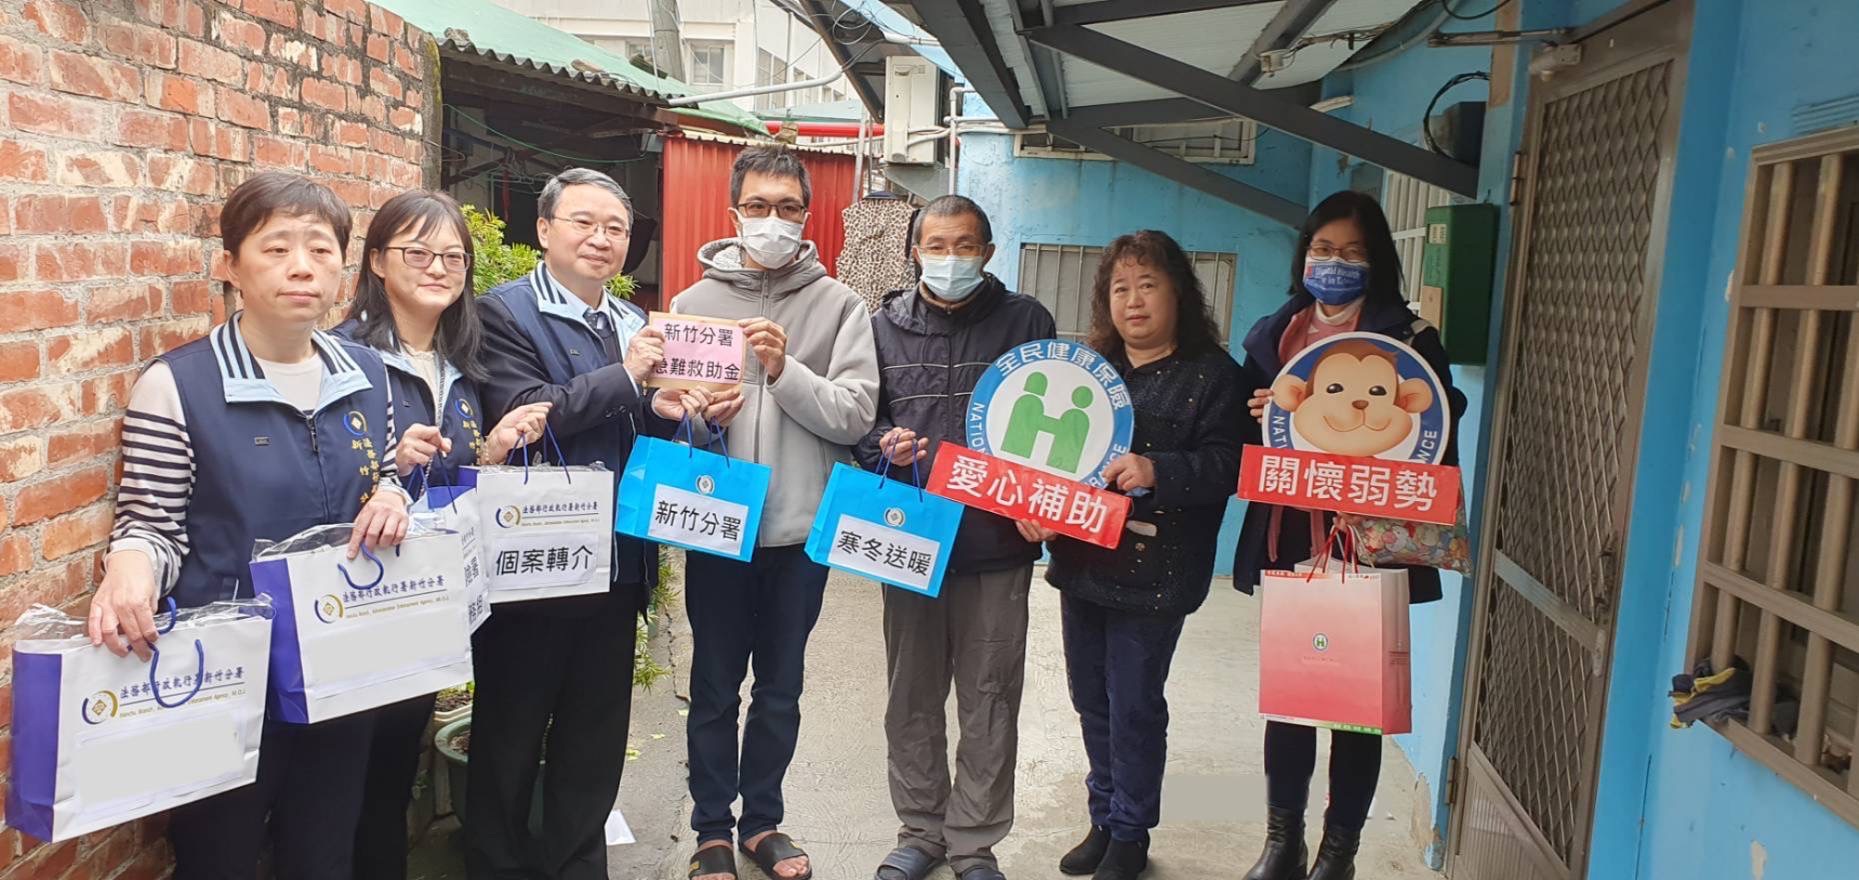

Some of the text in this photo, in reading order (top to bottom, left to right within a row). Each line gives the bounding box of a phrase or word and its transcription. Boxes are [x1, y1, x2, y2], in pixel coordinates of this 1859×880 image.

[664, 323, 733, 347] 新竹分署
[655, 358, 740, 381] 急難救助金
[995, 342, 1130, 410] 全民健康保險
[947, 454, 1109, 534] 愛心補助
[1257, 455, 1437, 512] 關懷弱勢
[655, 500, 742, 541] 新竹分署
[496, 545, 594, 576] 個案轉介
[837, 530, 932, 576] 寒冬送暖
